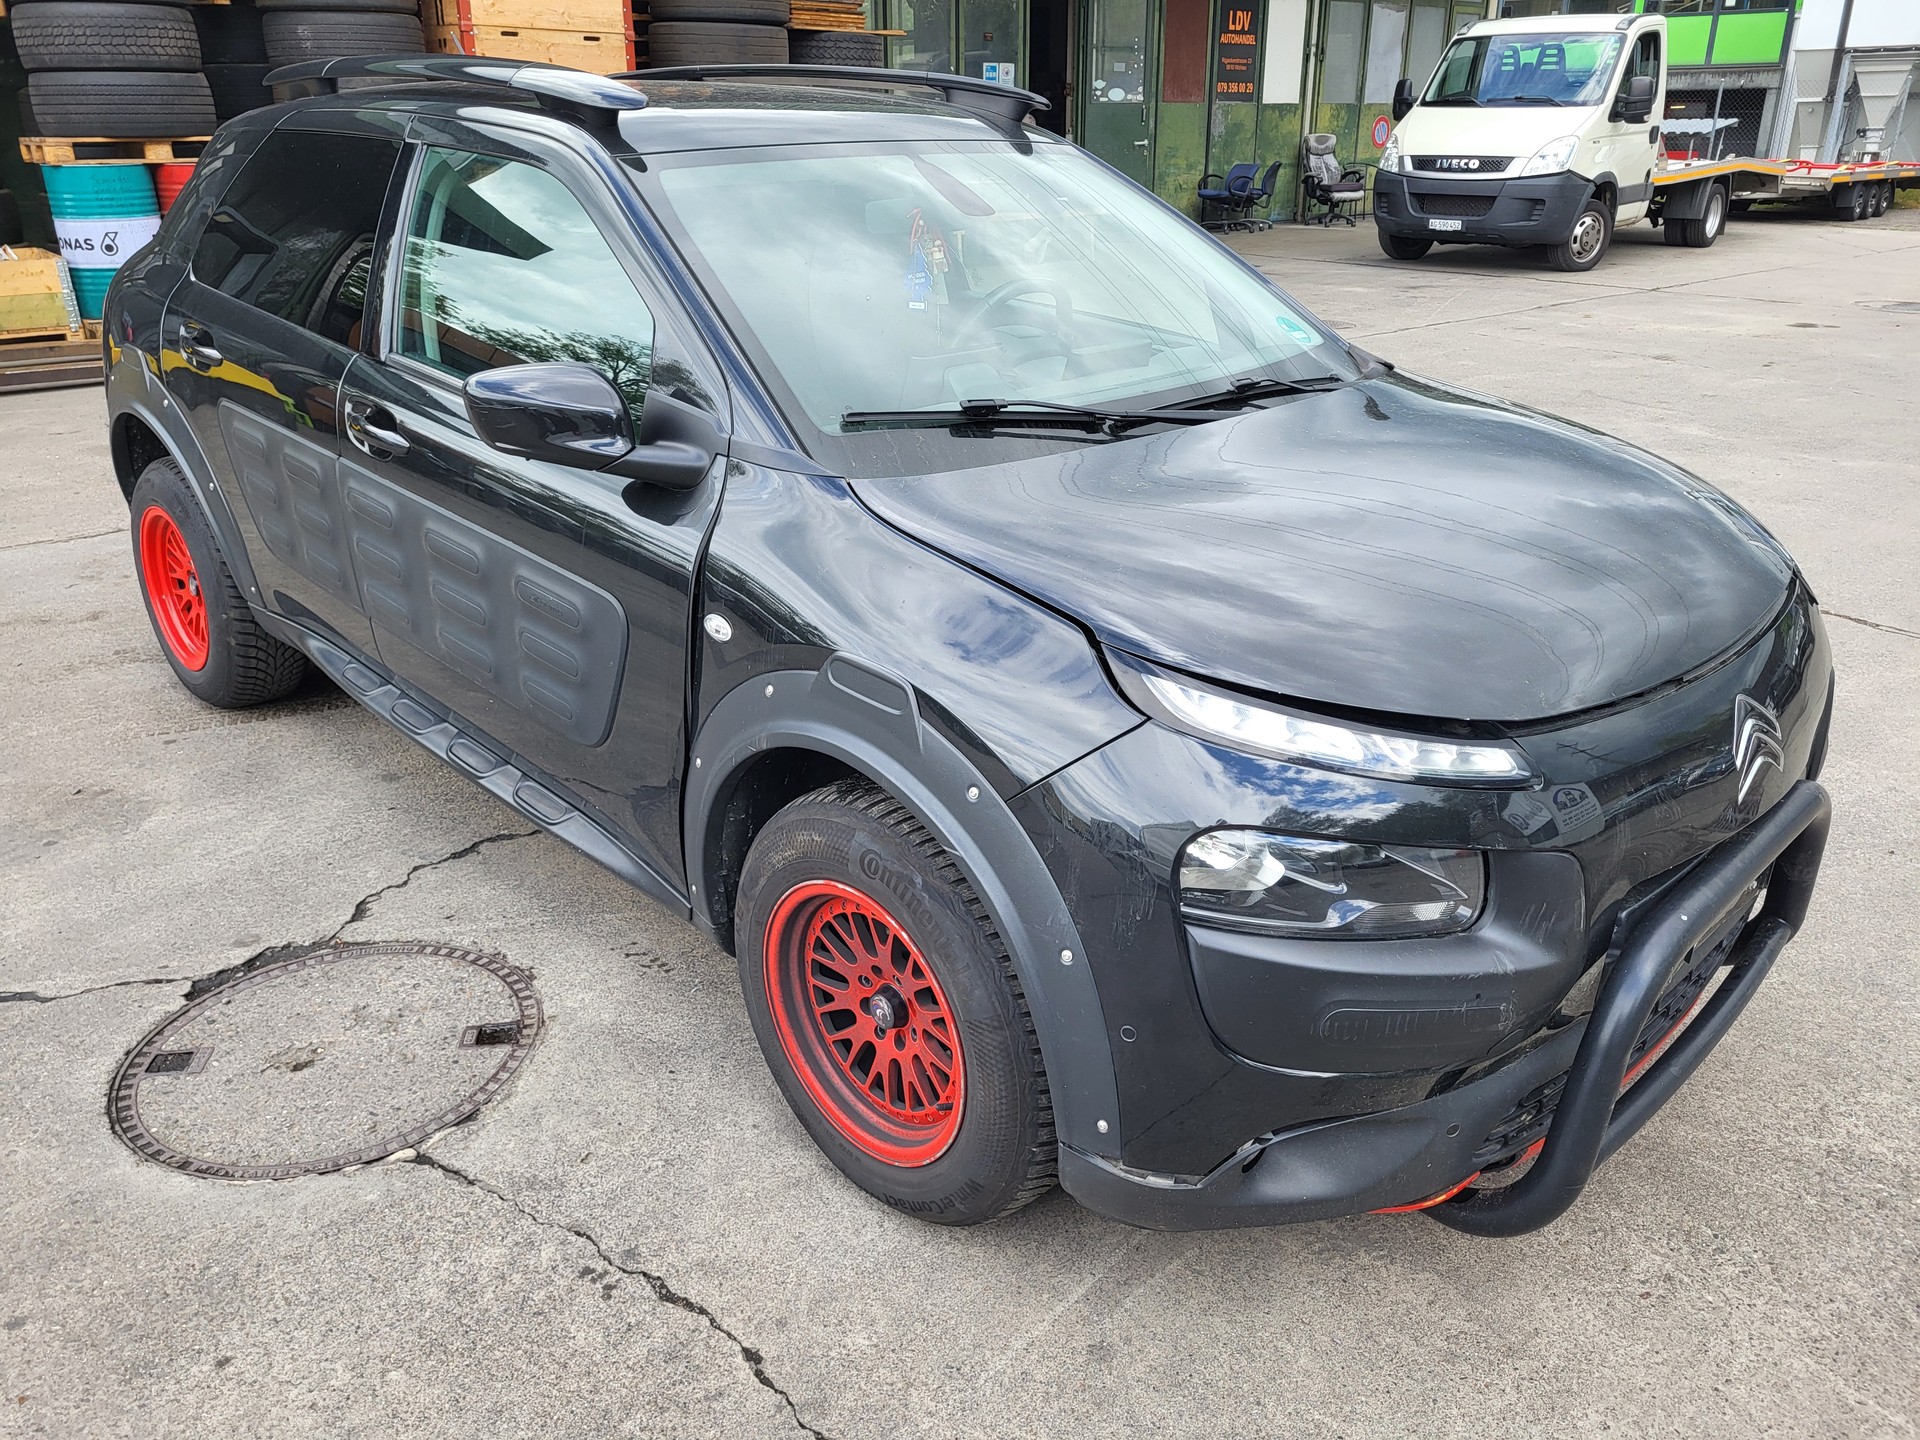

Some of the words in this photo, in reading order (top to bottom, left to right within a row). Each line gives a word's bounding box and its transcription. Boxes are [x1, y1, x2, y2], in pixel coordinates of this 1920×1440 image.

[1228, 10, 1252, 31] LDV
[1219, 33, 1256, 45] AUTOHANDEL
[1217, 82, 1228, 93] 079
[1228, 83, 1239, 92] 356
[1239, 83, 1246, 92] 00
[1246, 83, 1254, 93] 29
[1435, 158, 1480, 170] IVECO
[858, 848, 973, 976] Continenl
